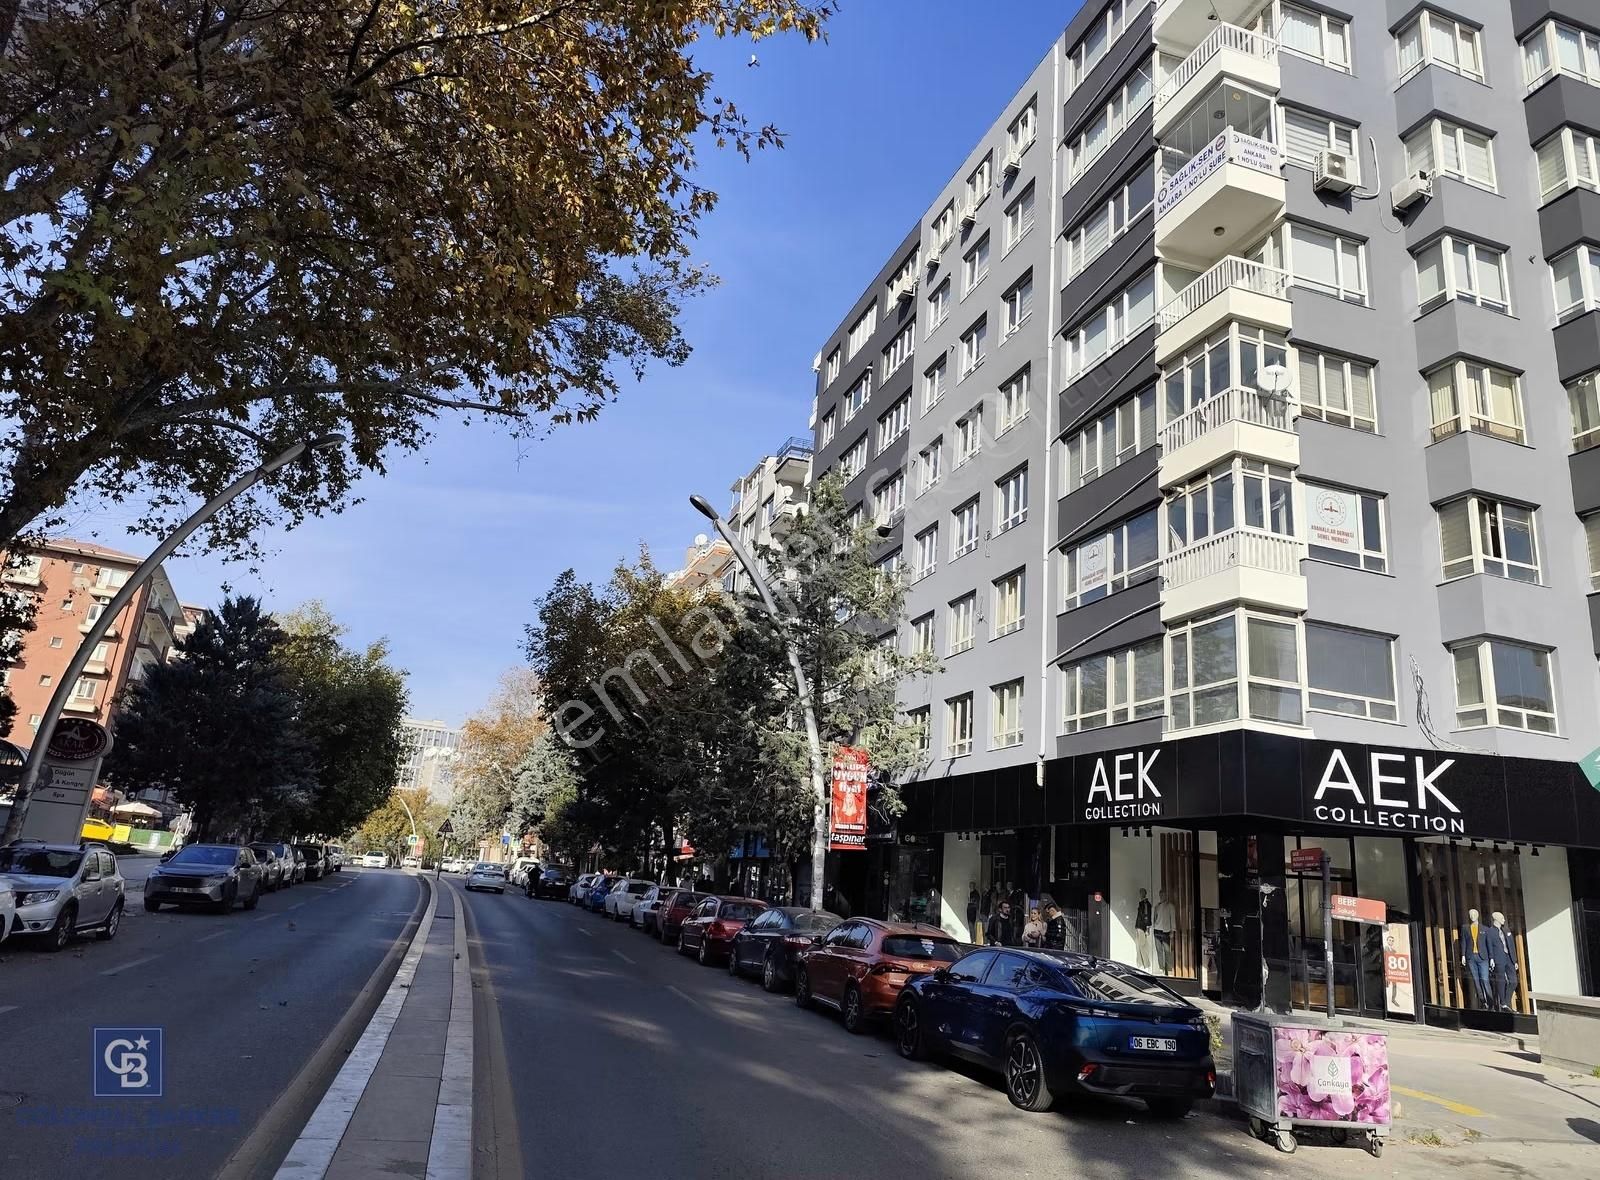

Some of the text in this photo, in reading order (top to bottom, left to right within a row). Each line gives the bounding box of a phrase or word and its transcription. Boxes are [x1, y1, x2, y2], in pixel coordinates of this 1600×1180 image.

[1243, 147, 1266, 160] ANKARA
[1158, 191, 1182, 215] ANKARA
[1087, 749, 1162, 803] AEK
[1313, 748, 1461, 814] AEK
[1085, 802, 1160, 820] COLLECTION
[1313, 805, 1465, 834] COLLECTION
[1337, 897, 1357, 907] BEBE
[1388, 955, 1408, 971] 80
[1134, 1038, 1176, 1050] 06 EBC 190
